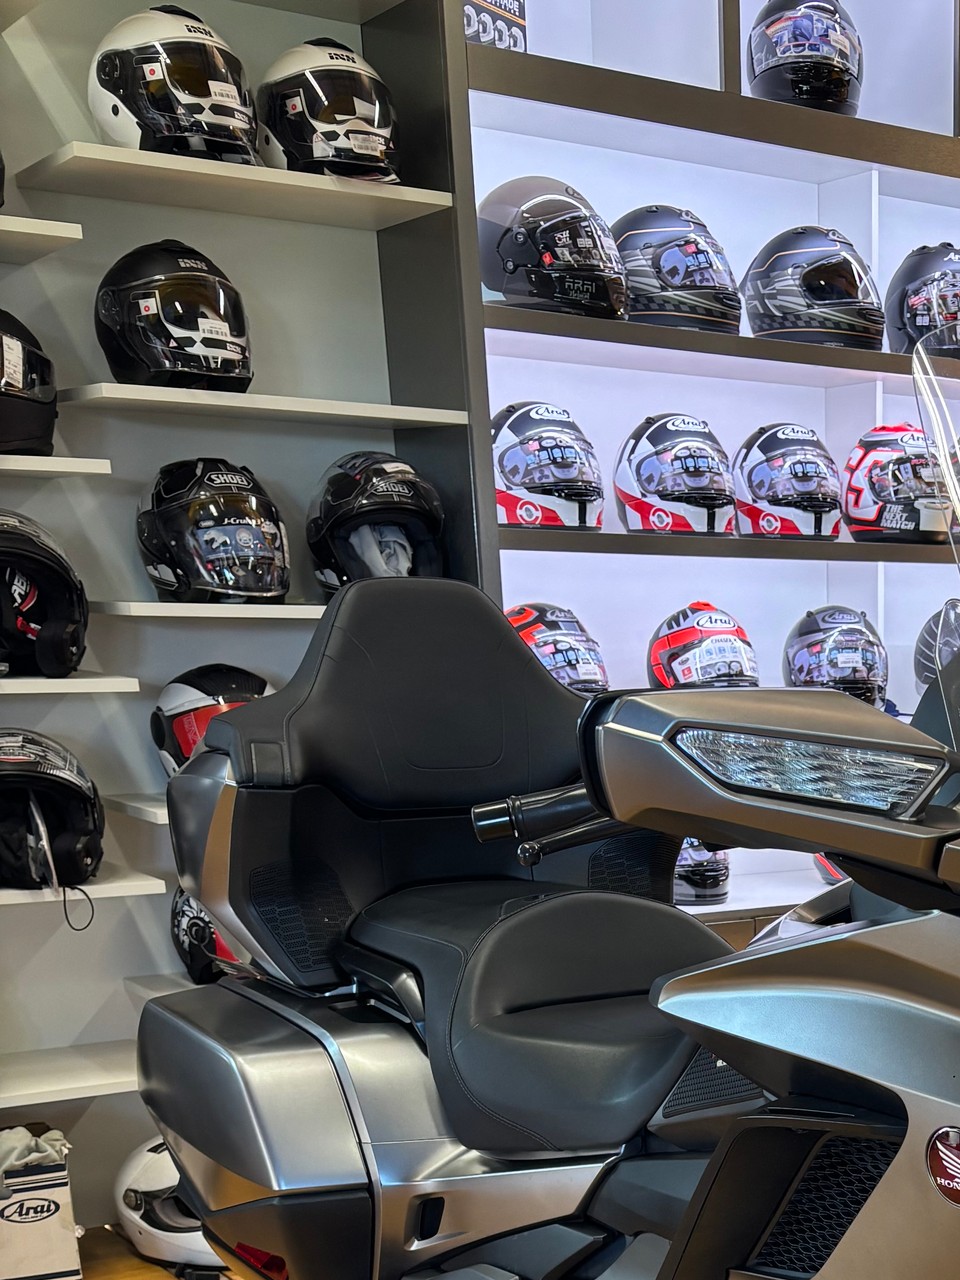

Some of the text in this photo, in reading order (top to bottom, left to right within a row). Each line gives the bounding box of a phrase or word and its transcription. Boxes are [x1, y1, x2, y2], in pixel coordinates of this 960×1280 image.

[536, 406, 570, 418] Arai
[674, 419, 703, 429] Arai
[786, 427, 812, 437] Arai
[210, 474, 250, 486] SHOEI
[376, 481, 410, 494] SHOEI
[886, 504, 905, 512] THE
[883, 512, 908, 521] NEXT
[880, 520, 916, 531] MATCH
[702, 615, 733, 626] Arai
[830, 612, 855, 620] Arai
[4, 1201, 54, 1218] Arai
